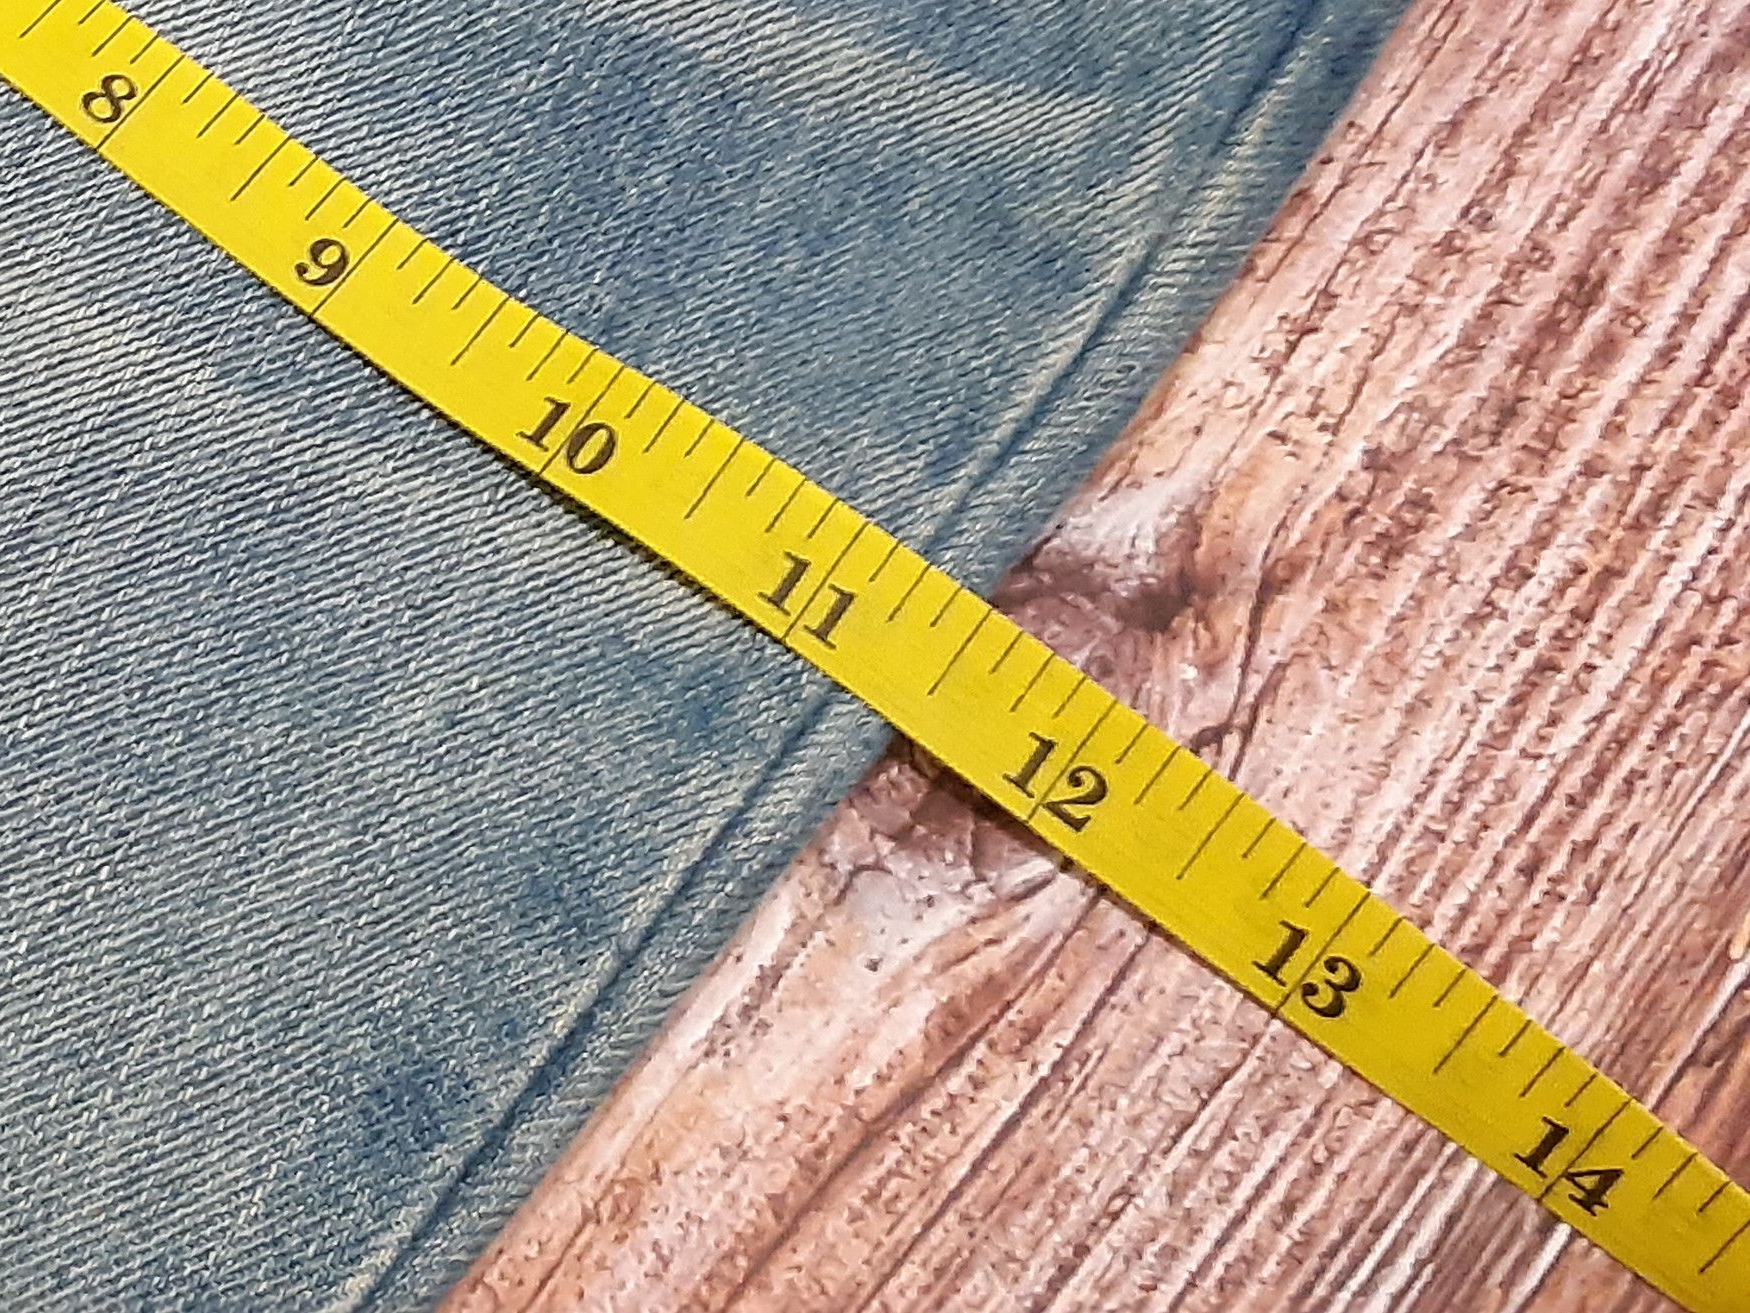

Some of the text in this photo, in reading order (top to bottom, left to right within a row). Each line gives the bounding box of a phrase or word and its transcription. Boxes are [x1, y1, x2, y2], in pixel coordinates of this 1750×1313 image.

[81, 74, 139, 124] 8
[294, 237, 350, 286] 9
[515, 395, 618, 475] 10
[757, 550, 858, 650] 11
[1002, 731, 1108, 833] 12
[1252, 919, 1363, 1019] 13
[1513, 1115, 1626, 1217] 14
